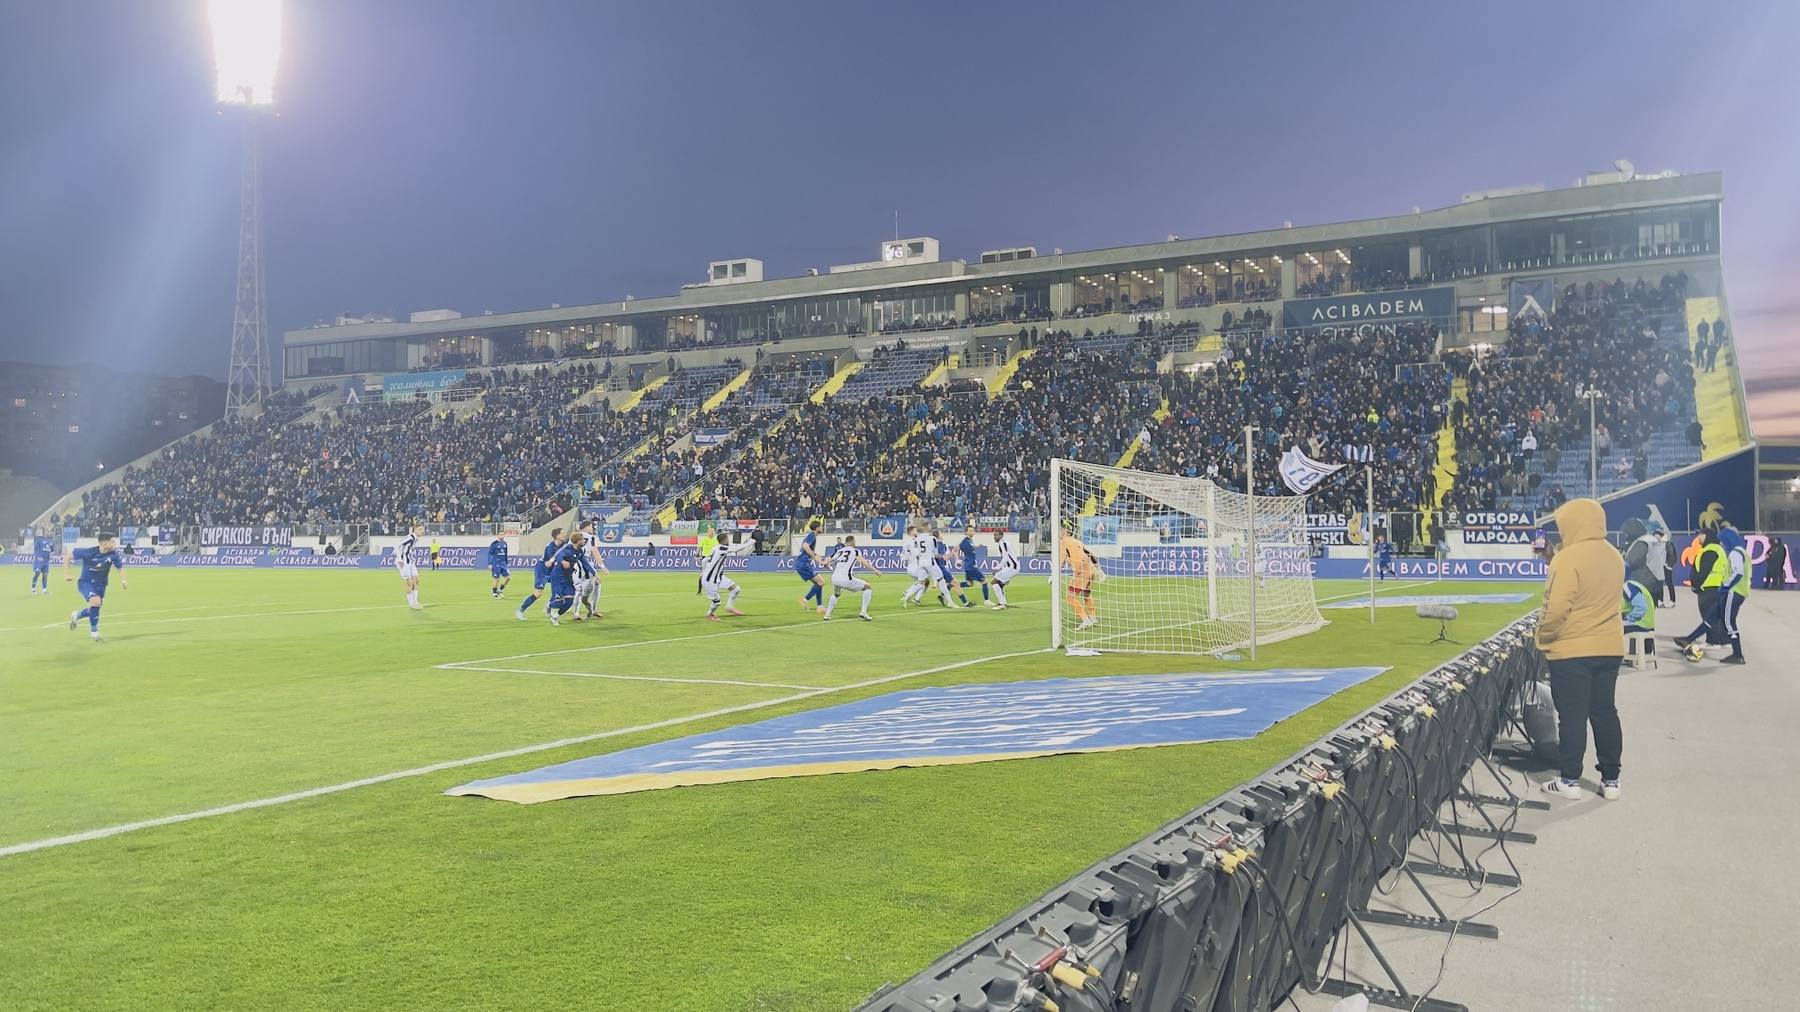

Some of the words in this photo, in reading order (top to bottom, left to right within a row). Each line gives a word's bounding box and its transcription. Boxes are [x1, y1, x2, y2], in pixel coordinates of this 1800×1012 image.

[1312, 299, 1424, 321] ACIBADEM
[1465, 512, 1530, 525] ОТБОРА
[201, 527, 252, 546] СИРАКОВ
[262, 527, 292, 546] ВЪН!
[1465, 531, 1530, 543] НАРОДА
[177, 556, 218, 565] ACIBADEM
[274, 556, 318, 565] ACIBADEM
[630, 558, 690, 568] ACIBADEM
